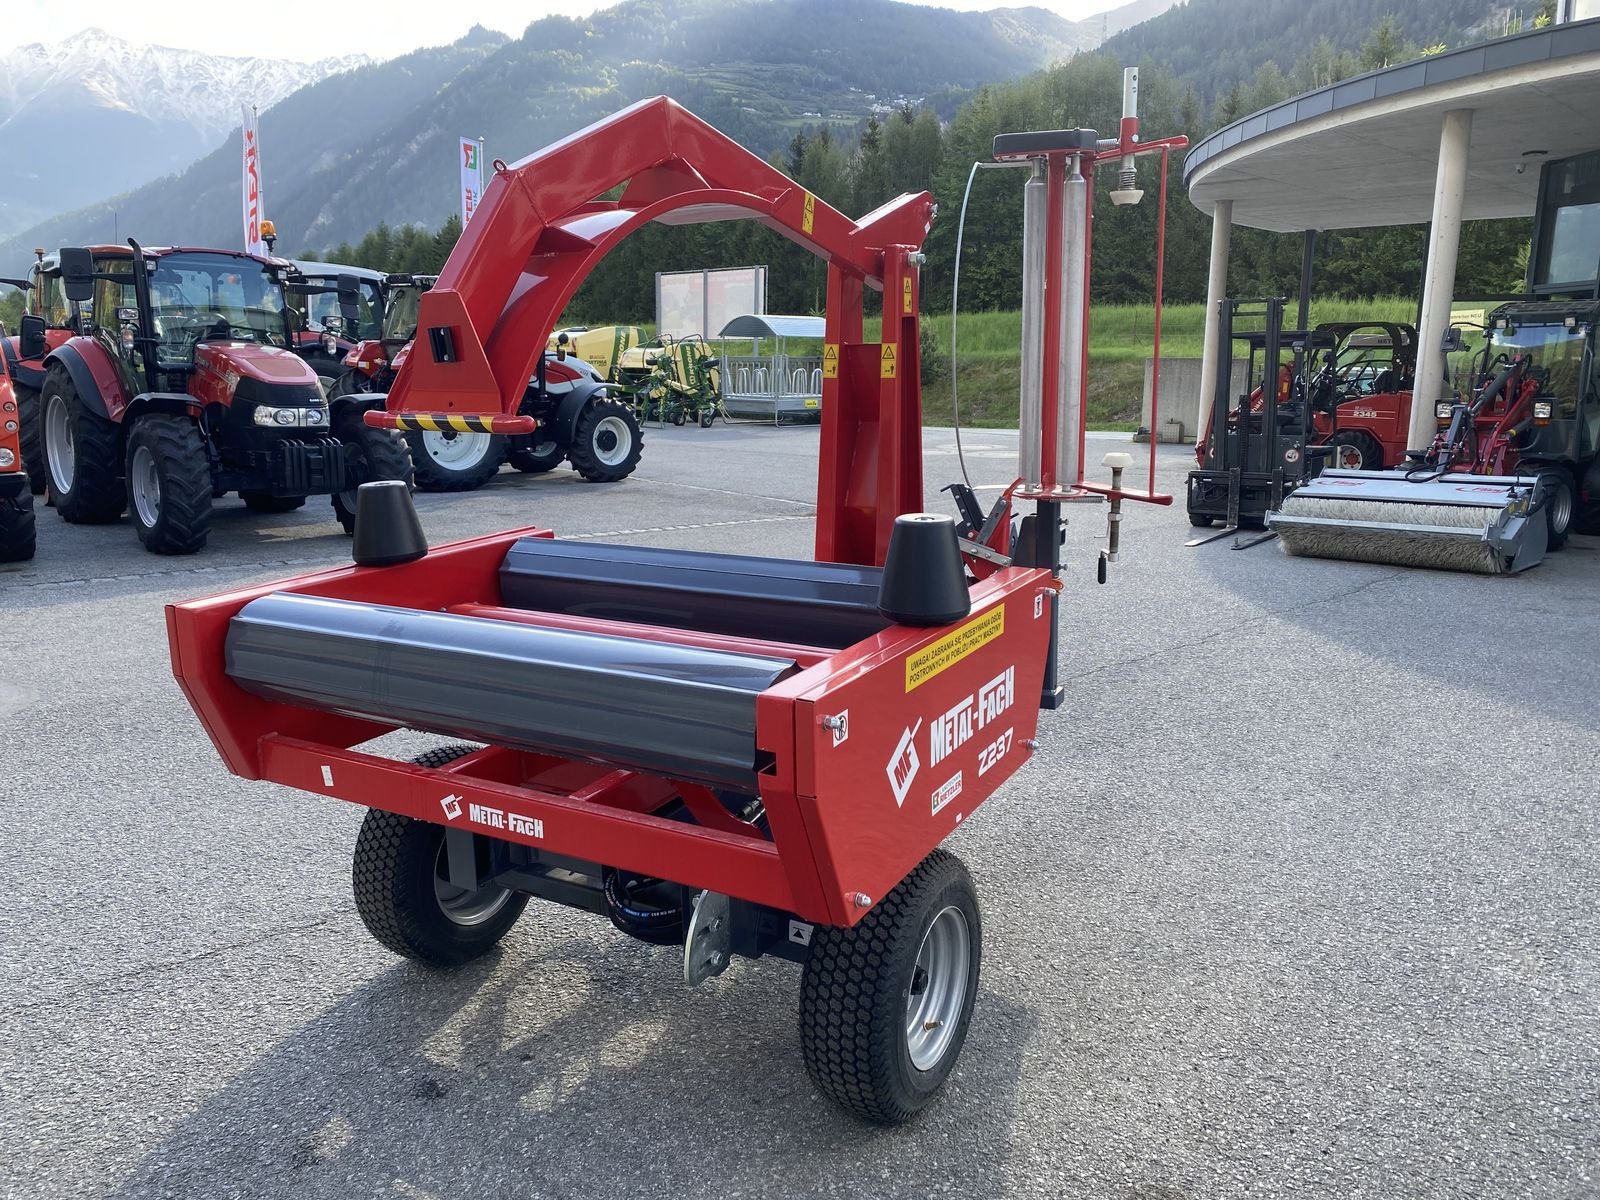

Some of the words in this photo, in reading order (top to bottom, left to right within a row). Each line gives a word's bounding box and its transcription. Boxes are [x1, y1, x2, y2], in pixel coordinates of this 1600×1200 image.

[909, 659, 945, 685] POSTRONNYCH
[969, 635, 983, 648] PRACY
[983, 624, 1001, 639] MASZYNY
[911, 655, 931, 671] UWAGA!
[931, 641, 954, 659] ZABRANIA
[962, 622, 991, 640] PRZEBYWANIA
[978, 726, 1014, 778] Z237
